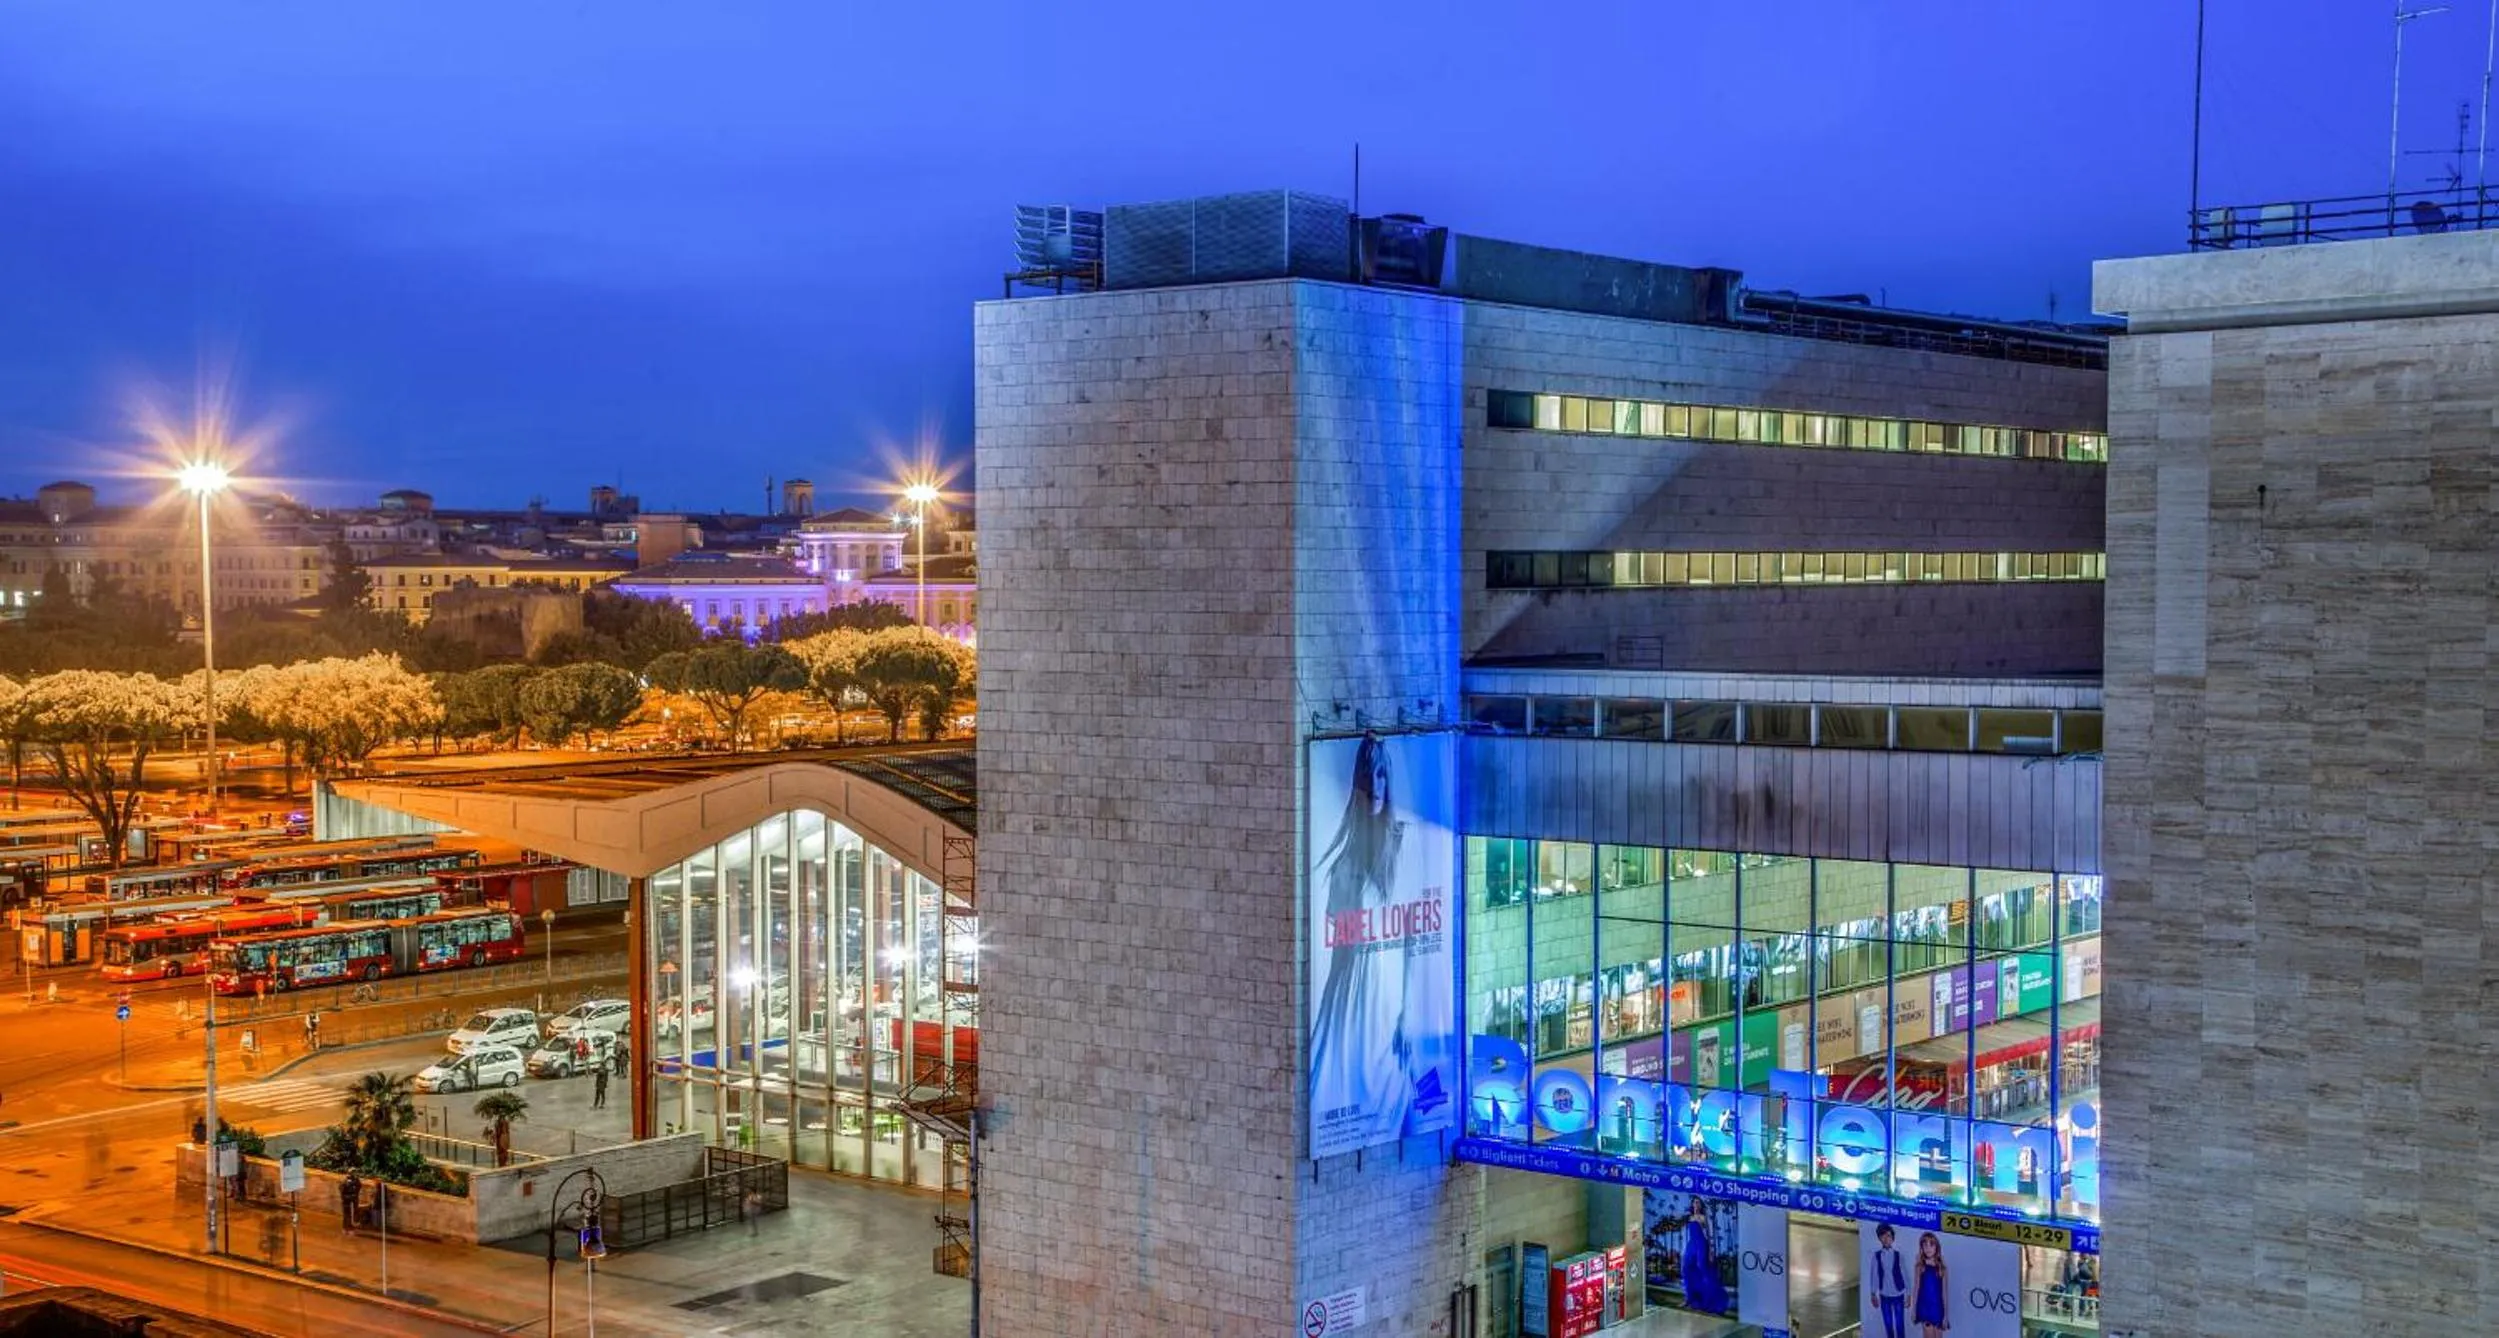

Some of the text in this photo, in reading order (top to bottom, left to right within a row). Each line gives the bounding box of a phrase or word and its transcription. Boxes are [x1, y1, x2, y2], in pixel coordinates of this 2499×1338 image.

[1324, 907, 1377, 948] LABEL
[1382, 899, 1442, 940] LOVERS
[1769, 1070, 2097, 1206] Termi
[1622, 1168, 1660, 1184] Metro
[1727, 1183, 1788, 1205] Shopping
[1742, 1250, 1785, 1276] OVS
[1969, 1287, 2017, 1315] OVS
